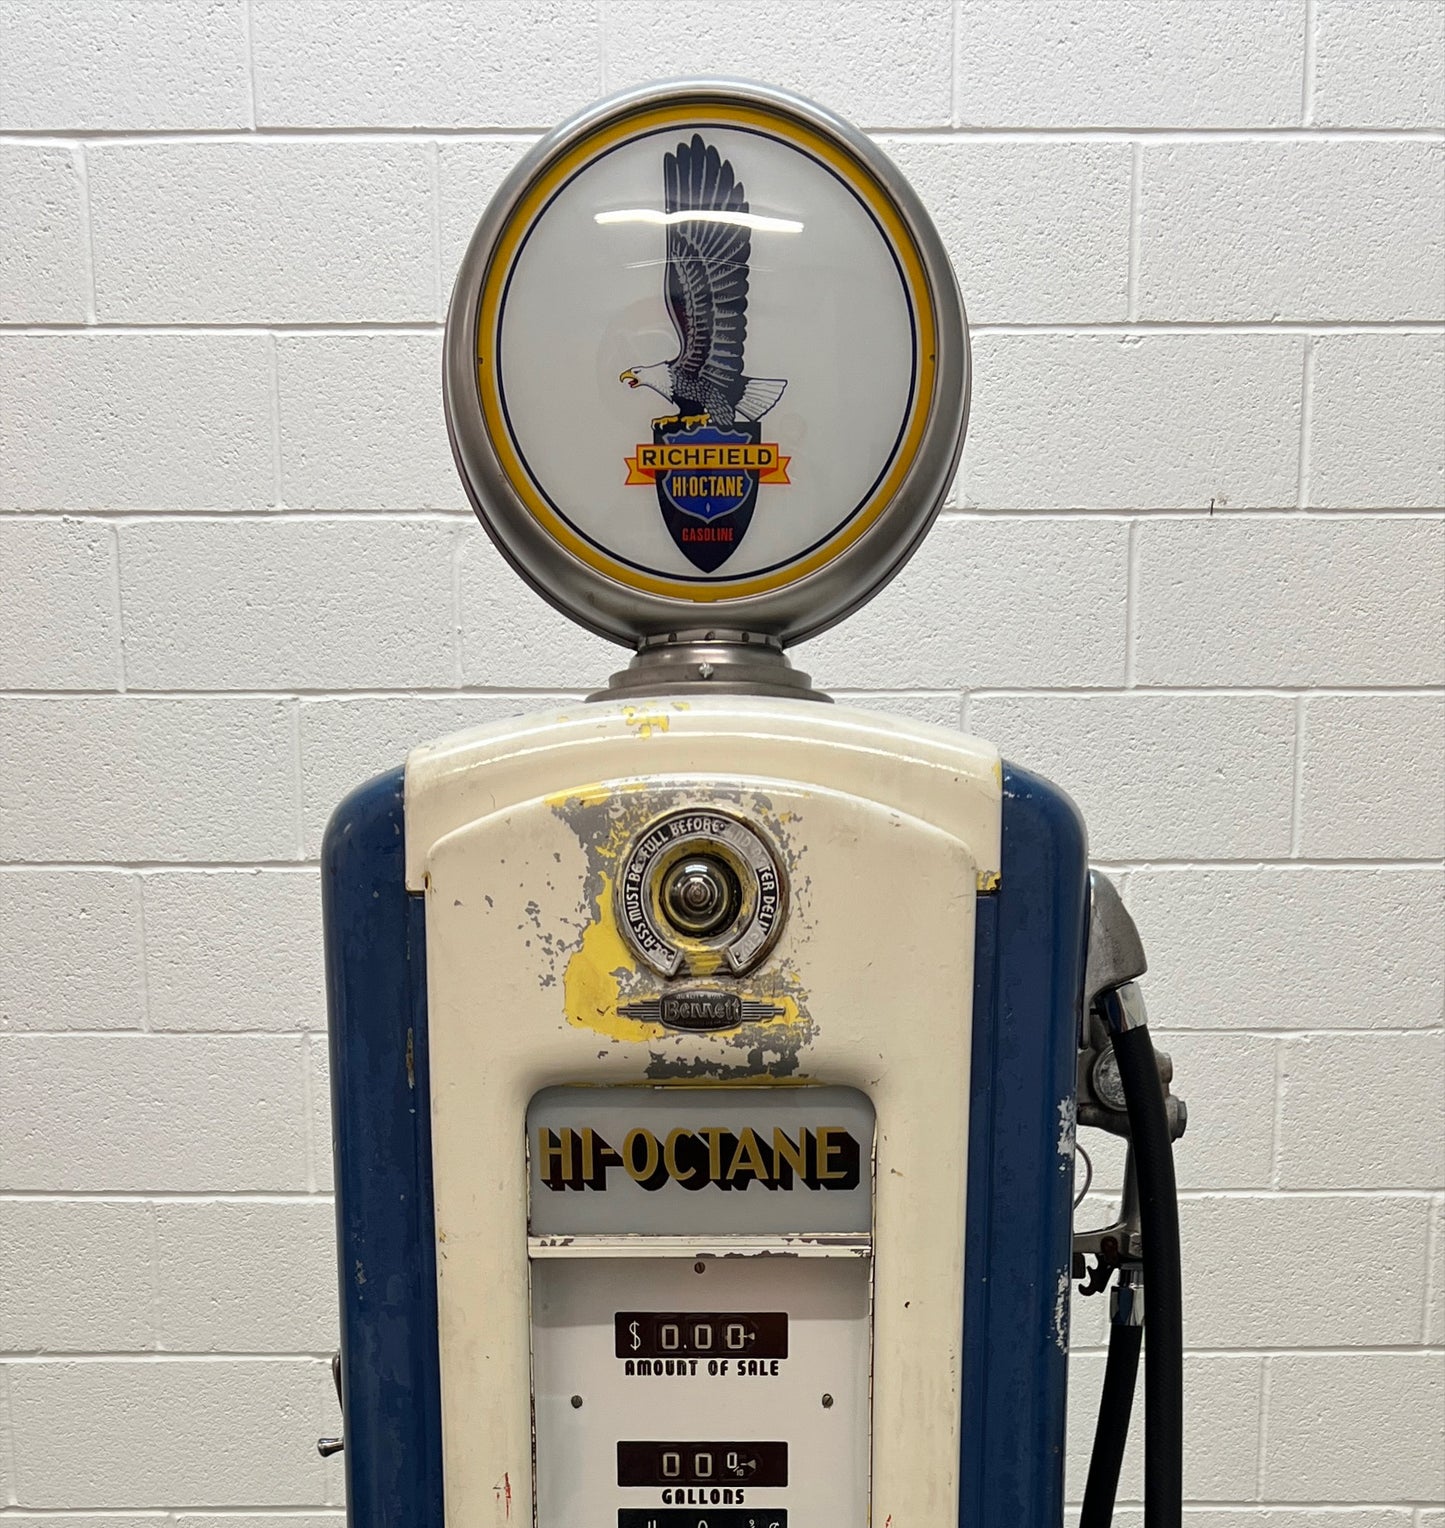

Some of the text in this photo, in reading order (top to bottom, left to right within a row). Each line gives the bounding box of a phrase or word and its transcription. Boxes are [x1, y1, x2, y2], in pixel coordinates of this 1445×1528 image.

[642, 449, 772, 466] RICHFIELD
[682, 527, 734, 542] GASOLINE
[669, 817, 720, 836] BEFORE
[640, 831, 669, 859] FULL
[628, 862, 642, 881] BE
[626, 884, 642, 921] MUST
[664, 998, 740, 1020] Bennett
[538, 1126, 858, 1189] HI-OCTANE
[625, 1360, 779, 1376] AMOUNT OF SALE
[661, 1489, 745, 1505] GALLONS
